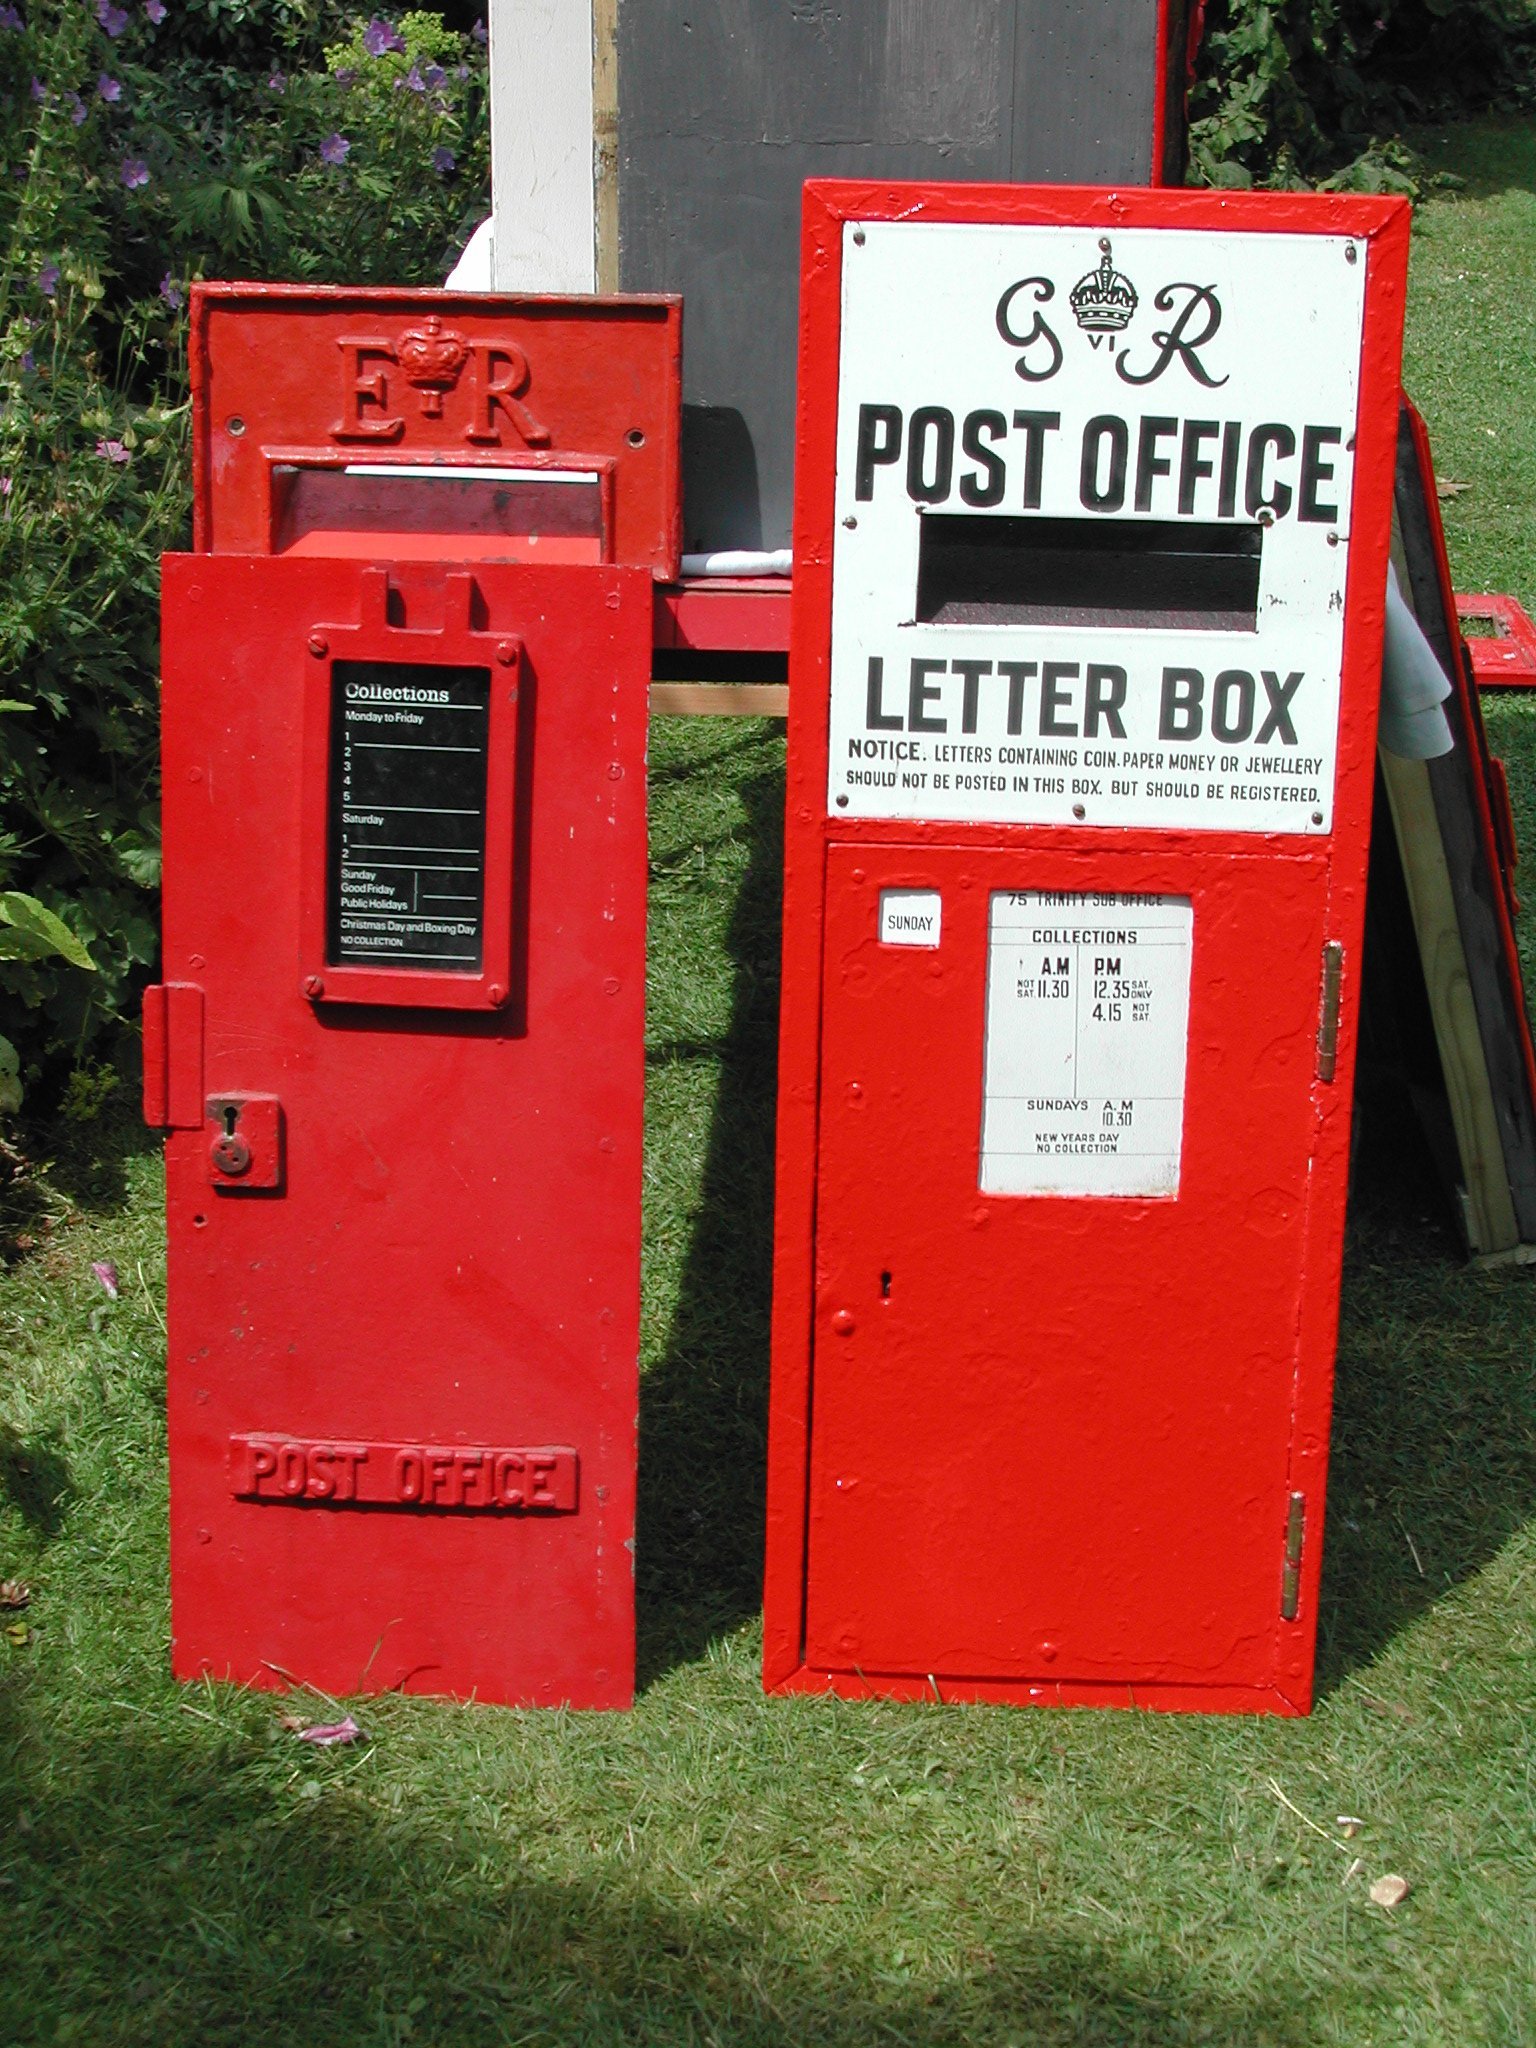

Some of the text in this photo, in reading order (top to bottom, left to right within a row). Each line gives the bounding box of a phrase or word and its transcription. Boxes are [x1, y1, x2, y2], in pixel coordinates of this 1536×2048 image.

[996, 276, 1230, 388] G VI R
[329, 336, 405, 440] E
[464, 338, 552, 443] R
[855, 403, 1342, 524] POST OFFICE
[345, 682, 450, 702] Collections
[866, 656, 1305, 746] LETTER BOX
[345, 710, 424, 725] Monday to Friday
[344, 731, 350, 741] 1
[344, 747, 351, 757] 2
[343, 761, 351, 772] 3
[935, 744, 992, 763] LETTERS
[998, 747, 1078, 767] CONTAINING
[1123, 752, 1164, 769] PAPER
[1169, 753, 1216, 772] MONEY
[1220, 756, 1239, 772] OR
[1245, 757, 1323, 775] JEWELLERY
[343, 776, 351, 785] 4
[846, 769, 1321, 803] SHOULD NOT BE POSTED IN THIS BOX. BUT SHOULD BE REGISTERED.
[343, 791, 351, 801] 5
[342, 813, 384, 826] Saturday
[342, 833, 348, 843] 1
[341, 849, 349, 858] 2
[341, 869, 376, 881] Sunday
[341, 882, 396, 896] Good Friday
[341, 897, 408, 911] Public Holidays
[1007, 893, 1027, 906] 75
[1037, 891, 1087, 907] TRINITY
[1121, 893, 1163, 907] OFFICE
[340, 918, 476, 936] Christmas Day and Boxing Day
[888, 915, 933, 931] SUNDAY
[340, 935, 404, 946] NO COLLECTION
[1032, 929, 1138, 944] COLLECTIONS
[1041, 957, 1069, 975] A.M
[1094, 957, 1121, 976] P.M
[1017, 979, 1034, 988] NOT
[1038, 980, 1069, 998] 11.30
[1094, 980, 1130, 999] 12.35
[1131, 990, 1153, 999] ONLY
[1092, 1003, 1121, 1021] 4.15
[1132, 1003, 1150, 1011] NOT
[1027, 1100, 1088, 1110] SUNDAYS
[1102, 1112, 1132, 1126] 10.30
[1035, 1133, 1119, 1143] NEW YEARS DAY
[1037, 1143, 1117, 1153] NO COLLECTION
[245, 1440, 557, 1508] POST OFFICE
